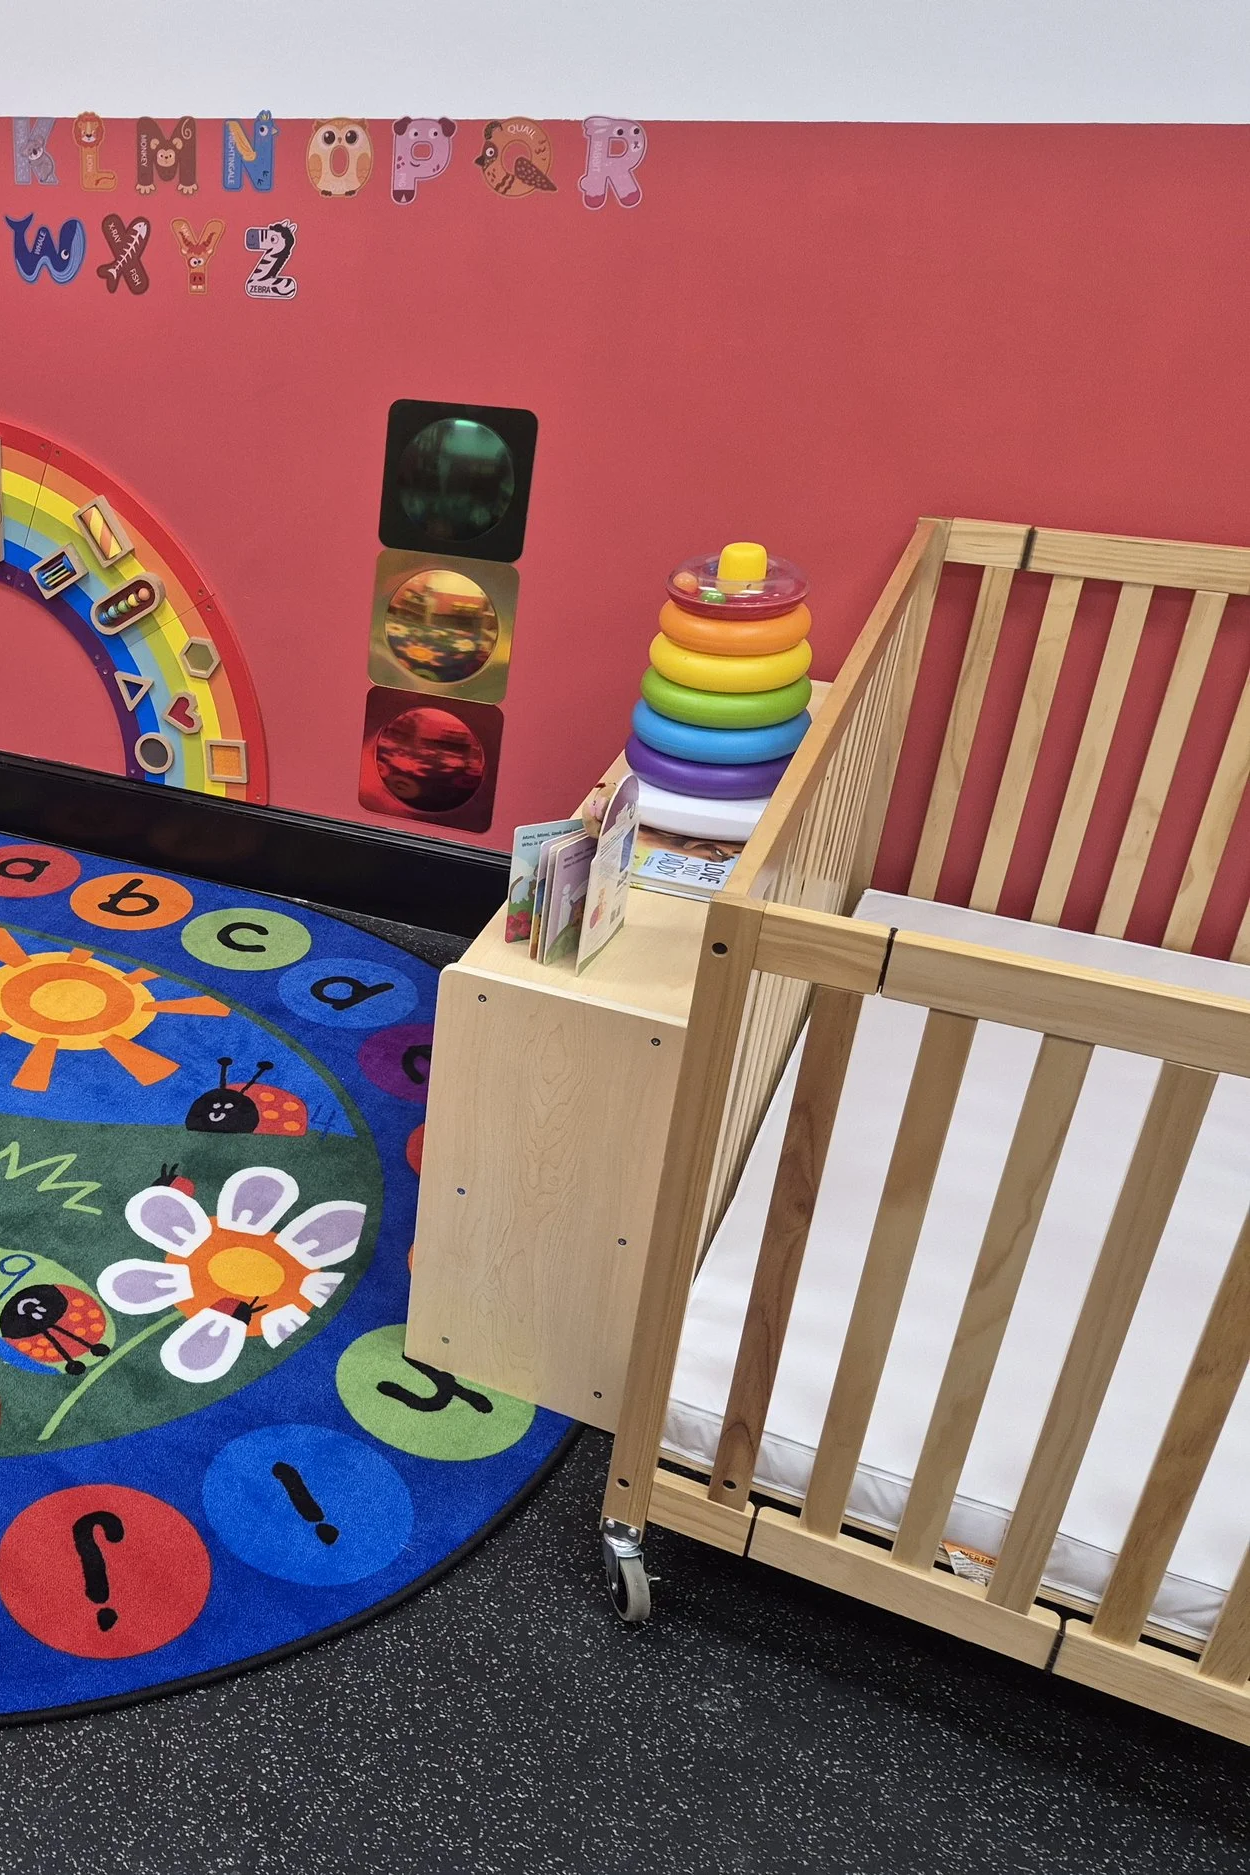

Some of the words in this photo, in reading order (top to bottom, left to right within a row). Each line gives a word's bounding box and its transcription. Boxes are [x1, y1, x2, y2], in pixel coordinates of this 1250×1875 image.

[507, 124, 537, 140] QUAIL
[140, 134, 148, 167] MONKEY
[34, 230, 46, 256] WHALE
[108, 222, 121, 244] X-RAY
[129, 268, 142, 287] FISH
[250, 286, 271, 294] ZEBRA
[656, 853, 689, 878] DADDY
[683, 863, 703, 877] YOU
[699, 863, 726, 884] LOVE
[98, 879, 160, 917] b
[216, 921, 269, 953] c
[310, 976, 395, 1011] d
[309, 1104, 336, 1141] 4
[273, 1462, 339, 1545] i
[72, 1511, 125, 1632] j
